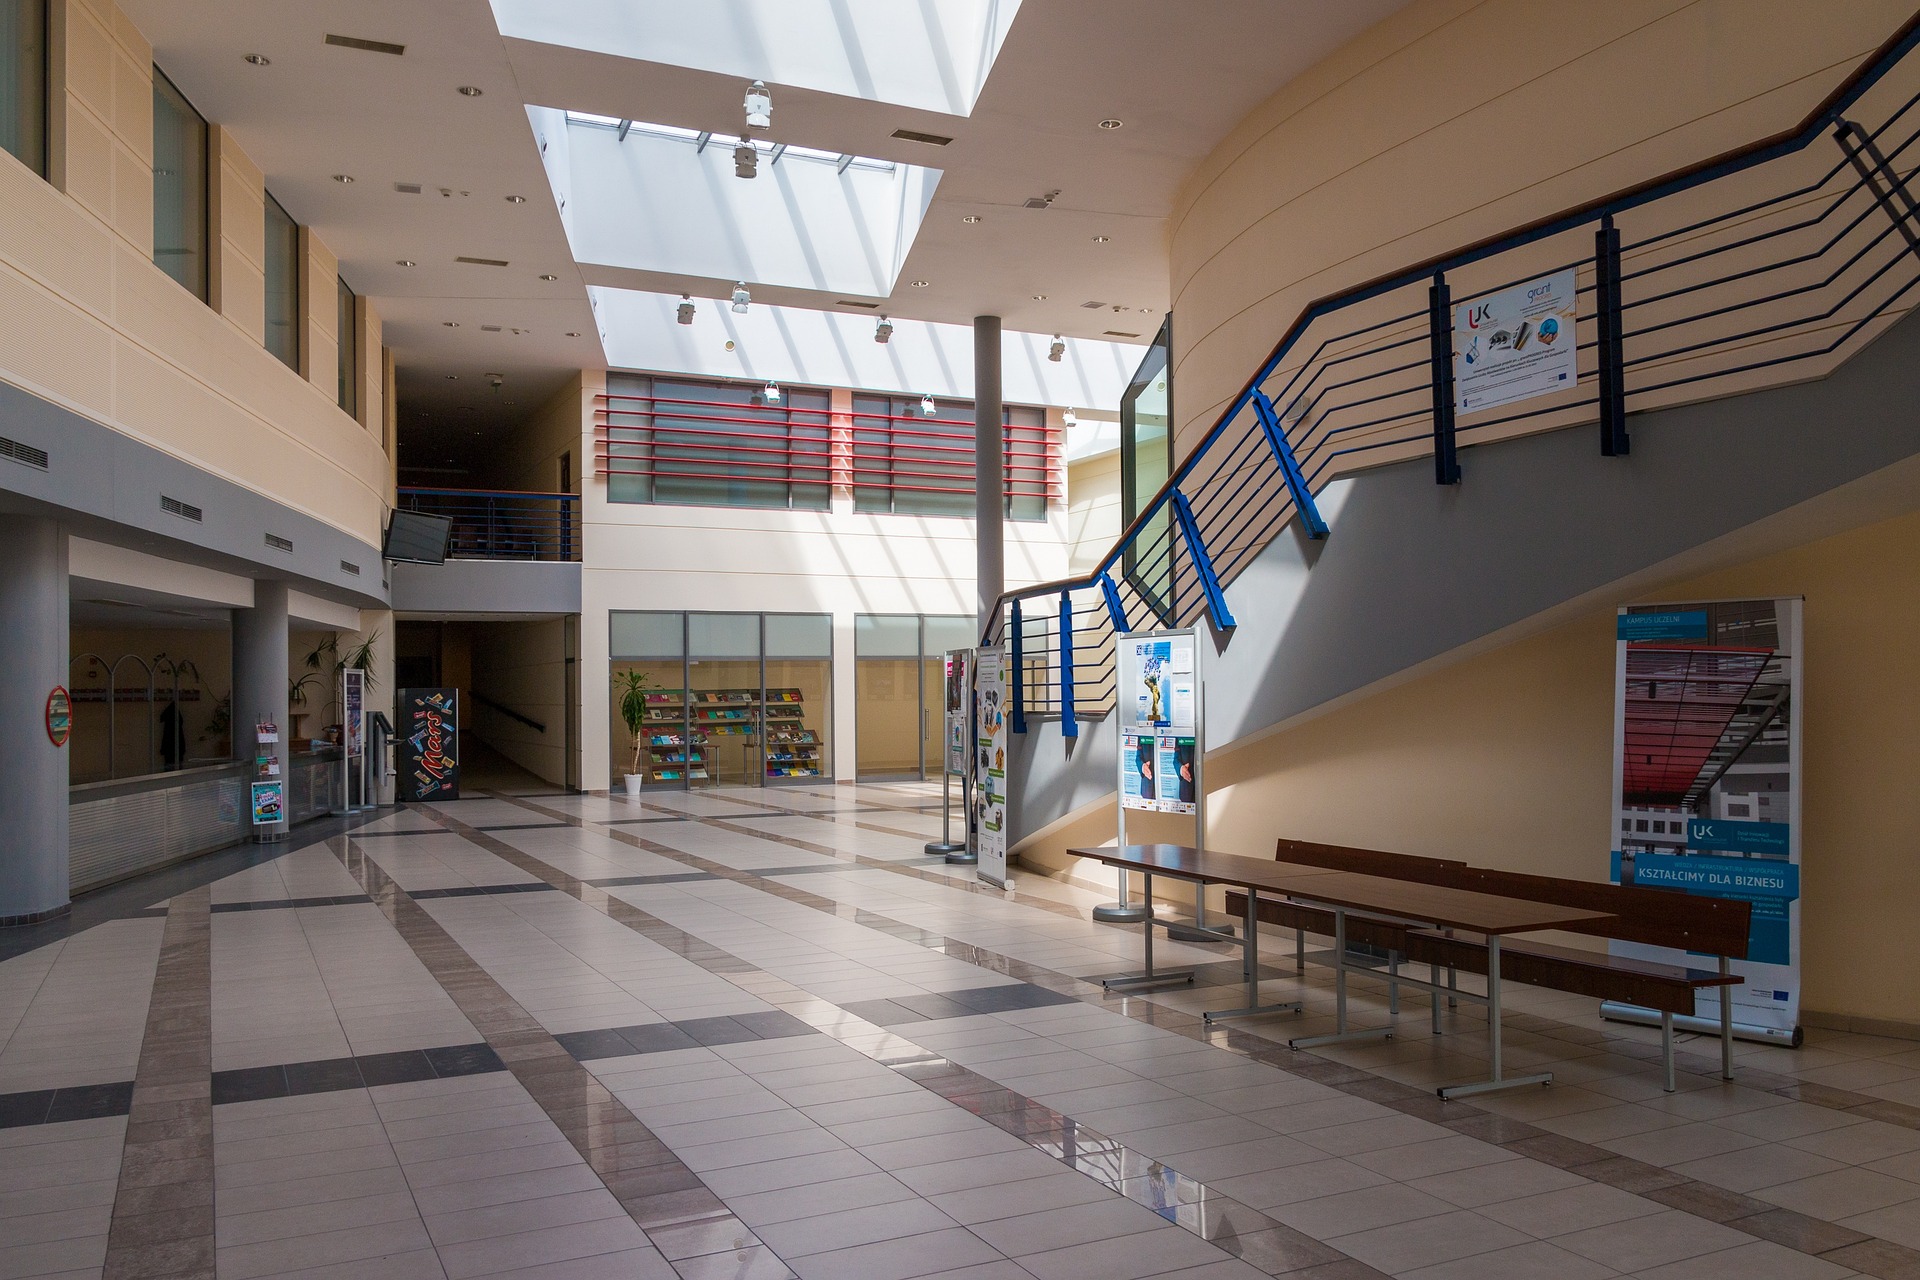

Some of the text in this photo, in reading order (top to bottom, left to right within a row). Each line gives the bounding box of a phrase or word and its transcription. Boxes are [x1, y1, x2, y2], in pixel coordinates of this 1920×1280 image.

[1626, 615, 1680, 624] KAMPUS UCZELNI
[421, 711, 444, 779] Mars
[1639, 868, 1784, 889] KSZTAŁCIMY DLA BIZNESU
